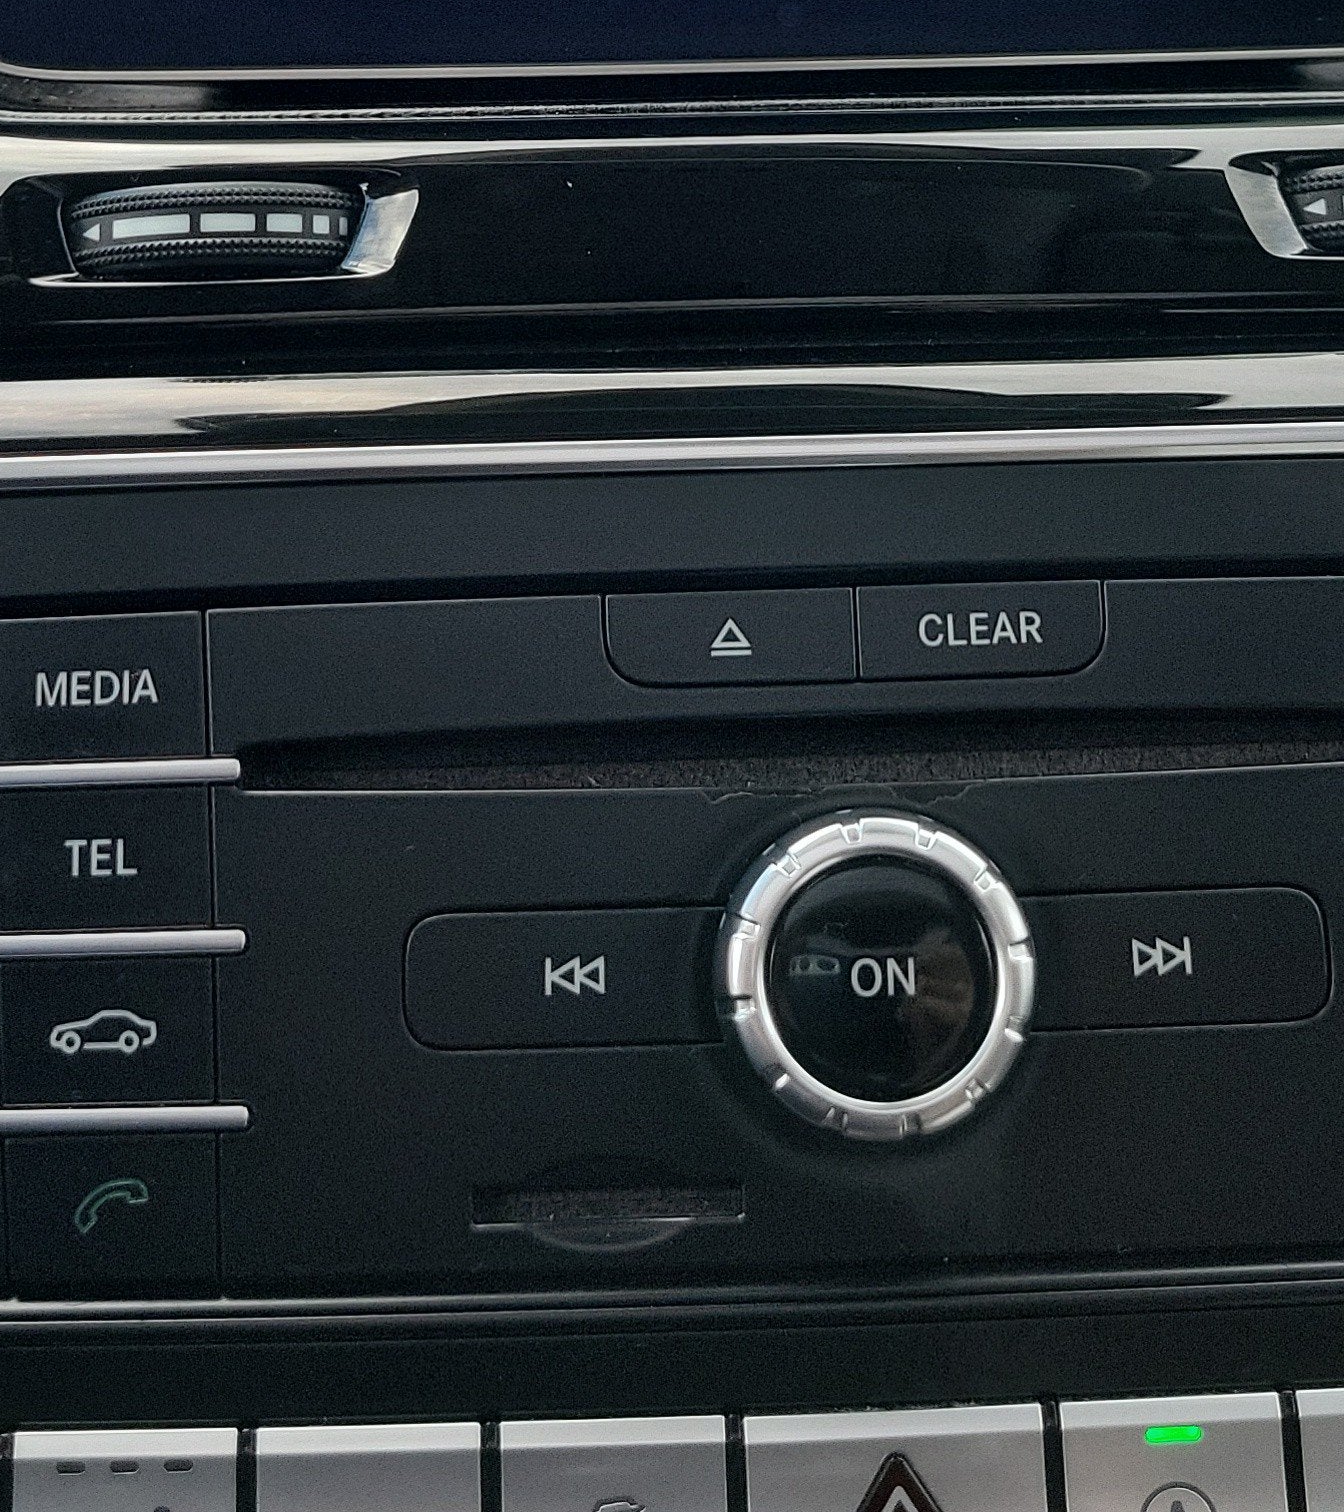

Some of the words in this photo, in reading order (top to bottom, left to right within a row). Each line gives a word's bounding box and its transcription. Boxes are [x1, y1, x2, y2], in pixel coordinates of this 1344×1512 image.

[917, 610, 1044, 647] CLEAR
[34, 668, 159, 708] MEDIA
[63, 838, 138, 877] TEL
[850, 956, 917, 998] ON
